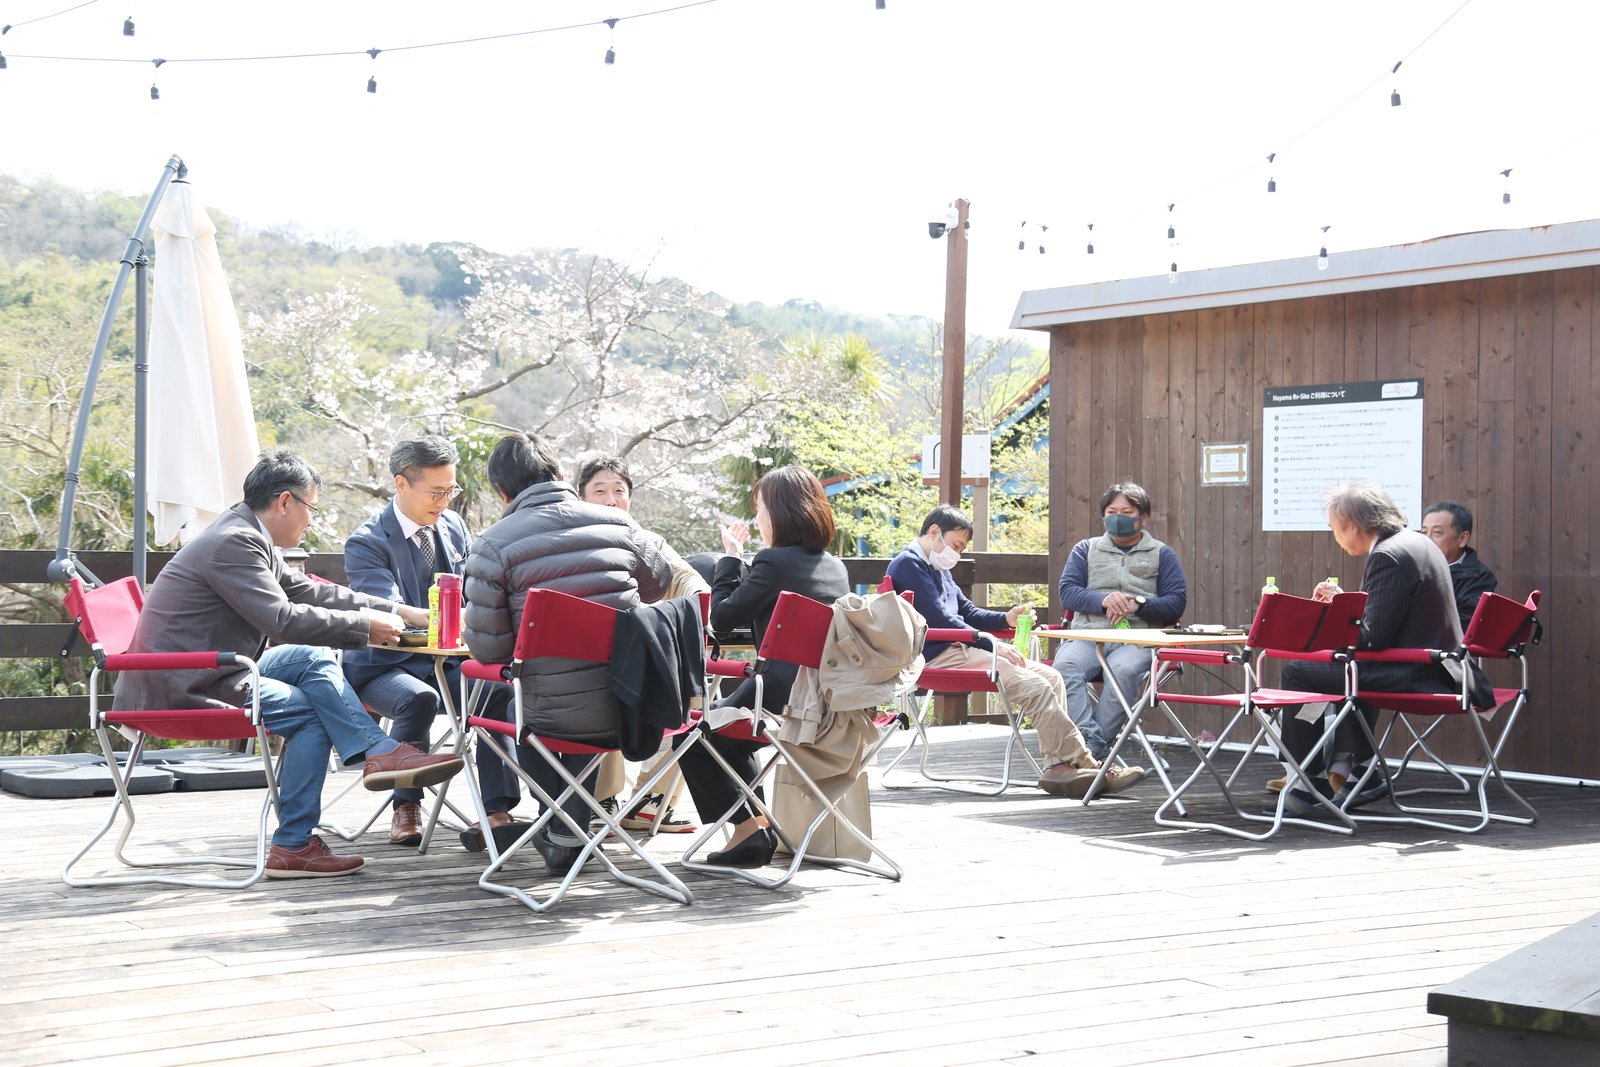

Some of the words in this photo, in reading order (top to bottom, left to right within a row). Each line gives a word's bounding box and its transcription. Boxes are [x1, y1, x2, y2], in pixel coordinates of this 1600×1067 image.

[1310, 390, 1346, 399] ご利用について
